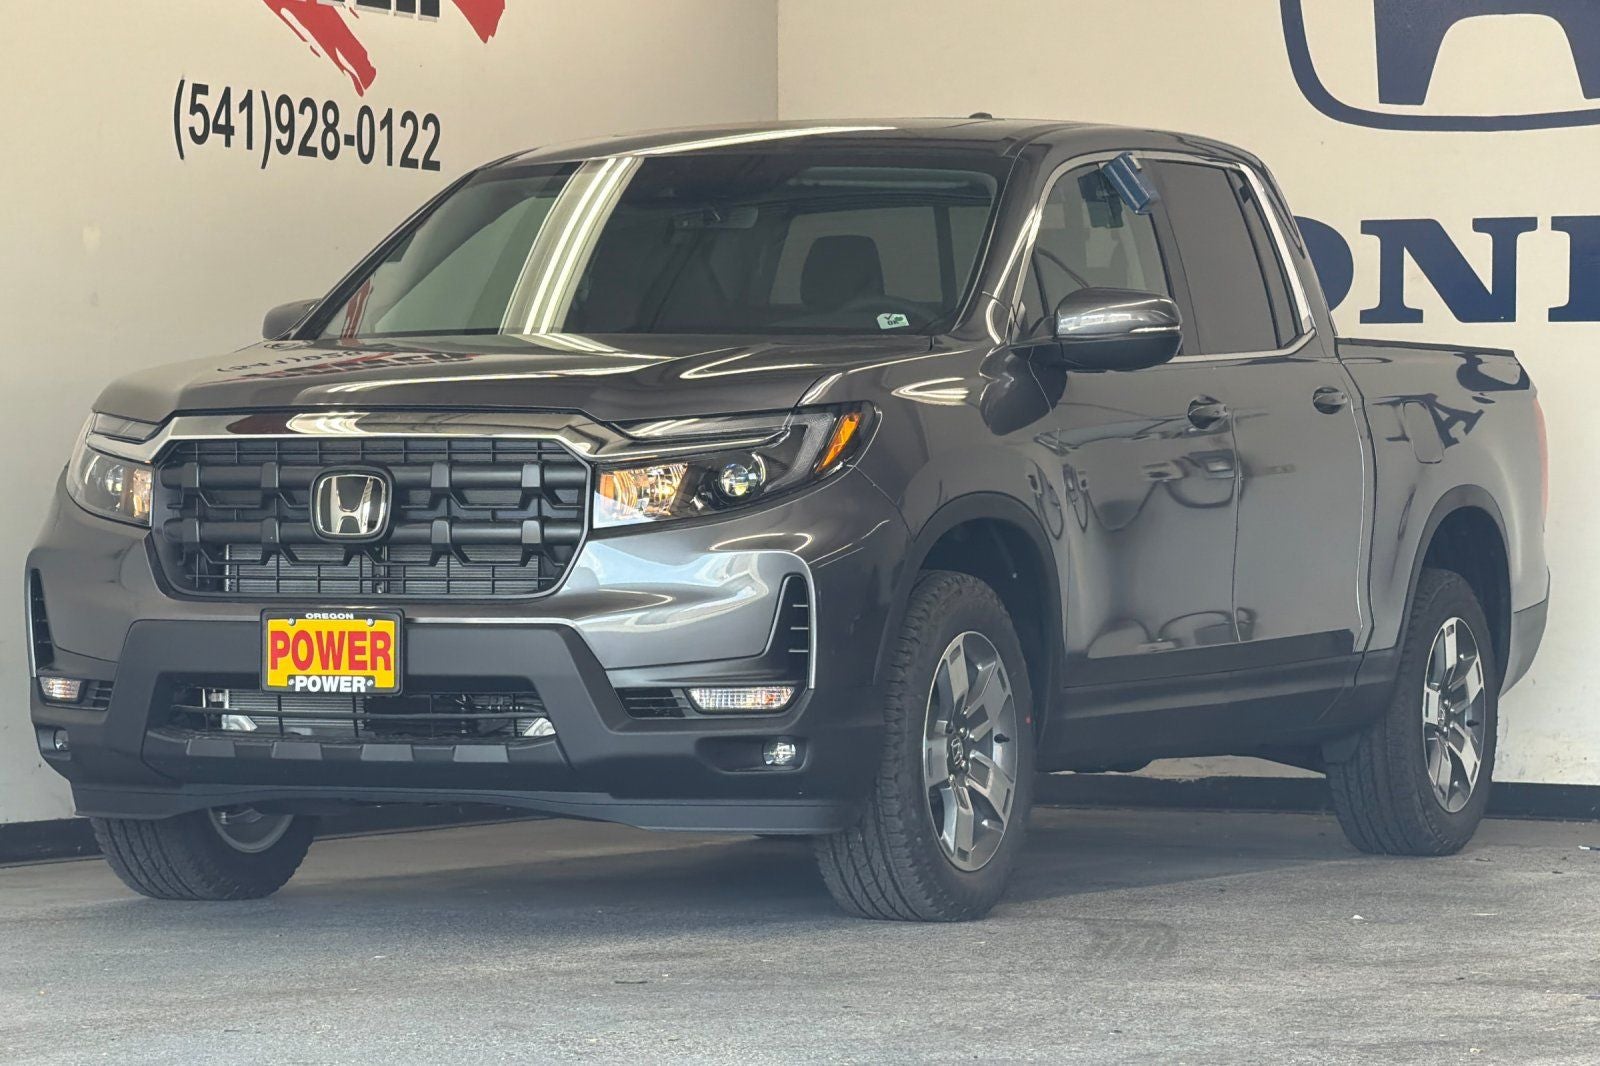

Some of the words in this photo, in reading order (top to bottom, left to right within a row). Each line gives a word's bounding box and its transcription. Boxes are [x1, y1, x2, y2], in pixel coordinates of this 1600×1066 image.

[173, 79, 441, 172] (541)928-0122
[305, 612, 354, 620] OREGON
[270, 630, 392, 671] POWER
[294, 675, 366, 693] POWER
